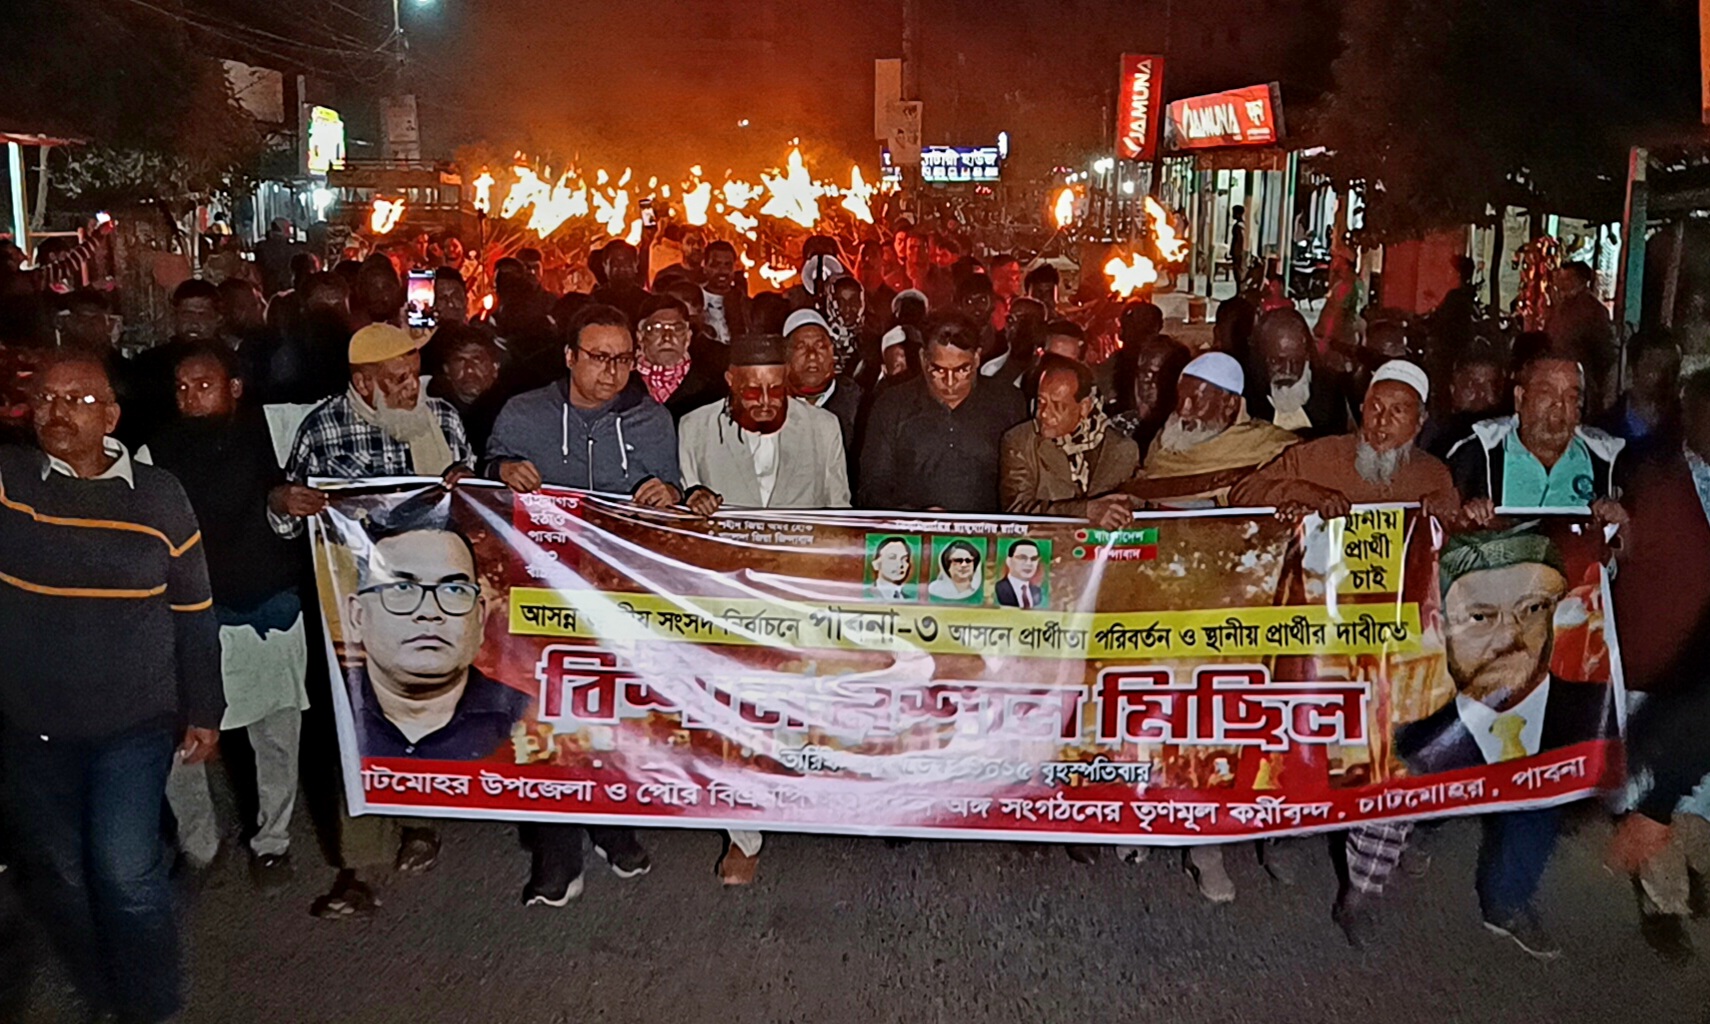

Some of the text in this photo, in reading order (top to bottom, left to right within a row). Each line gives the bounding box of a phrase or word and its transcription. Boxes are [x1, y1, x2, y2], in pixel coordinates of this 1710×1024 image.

[1123, 58, 1153, 158] JAMUNA
[527, 530, 568, 544] পাবনা
[1094, 545, 1142, 560] িন্দাবাদ
[1350, 563, 1388, 591] চাই
[520, 604, 579, 632] আসন্ন
[657, 611, 715, 635] সংসদ
[721, 608, 801, 638] নির্বাচনে
[809, 605, 939, 643] পাবনা-৩
[948, 622, 1014, 647] আসনে
[1095, 621, 1172, 650] পরিবর্তন
[1179, 629, 1197, 646] ও
[1201, 617, 1260, 652] স্থানীয়
[1266, 615, 1328, 647] প্রার্থীর
[1334, 613, 1409, 646] দাবীতে
[1093, 664, 1370, 750] মিছিল
[1041, 754, 1152, 787] বৃহস্পতিবার
[361, 764, 472, 795] াটমোহর
[480, 769, 597, 801] উপজেলা
[604, 782, 627, 801] ও
[999, 791, 1124, 823] সংগঠনের
[1130, 799, 1220, 832] তৃণমূল
[1511, 755, 1588, 790] পাবনা
